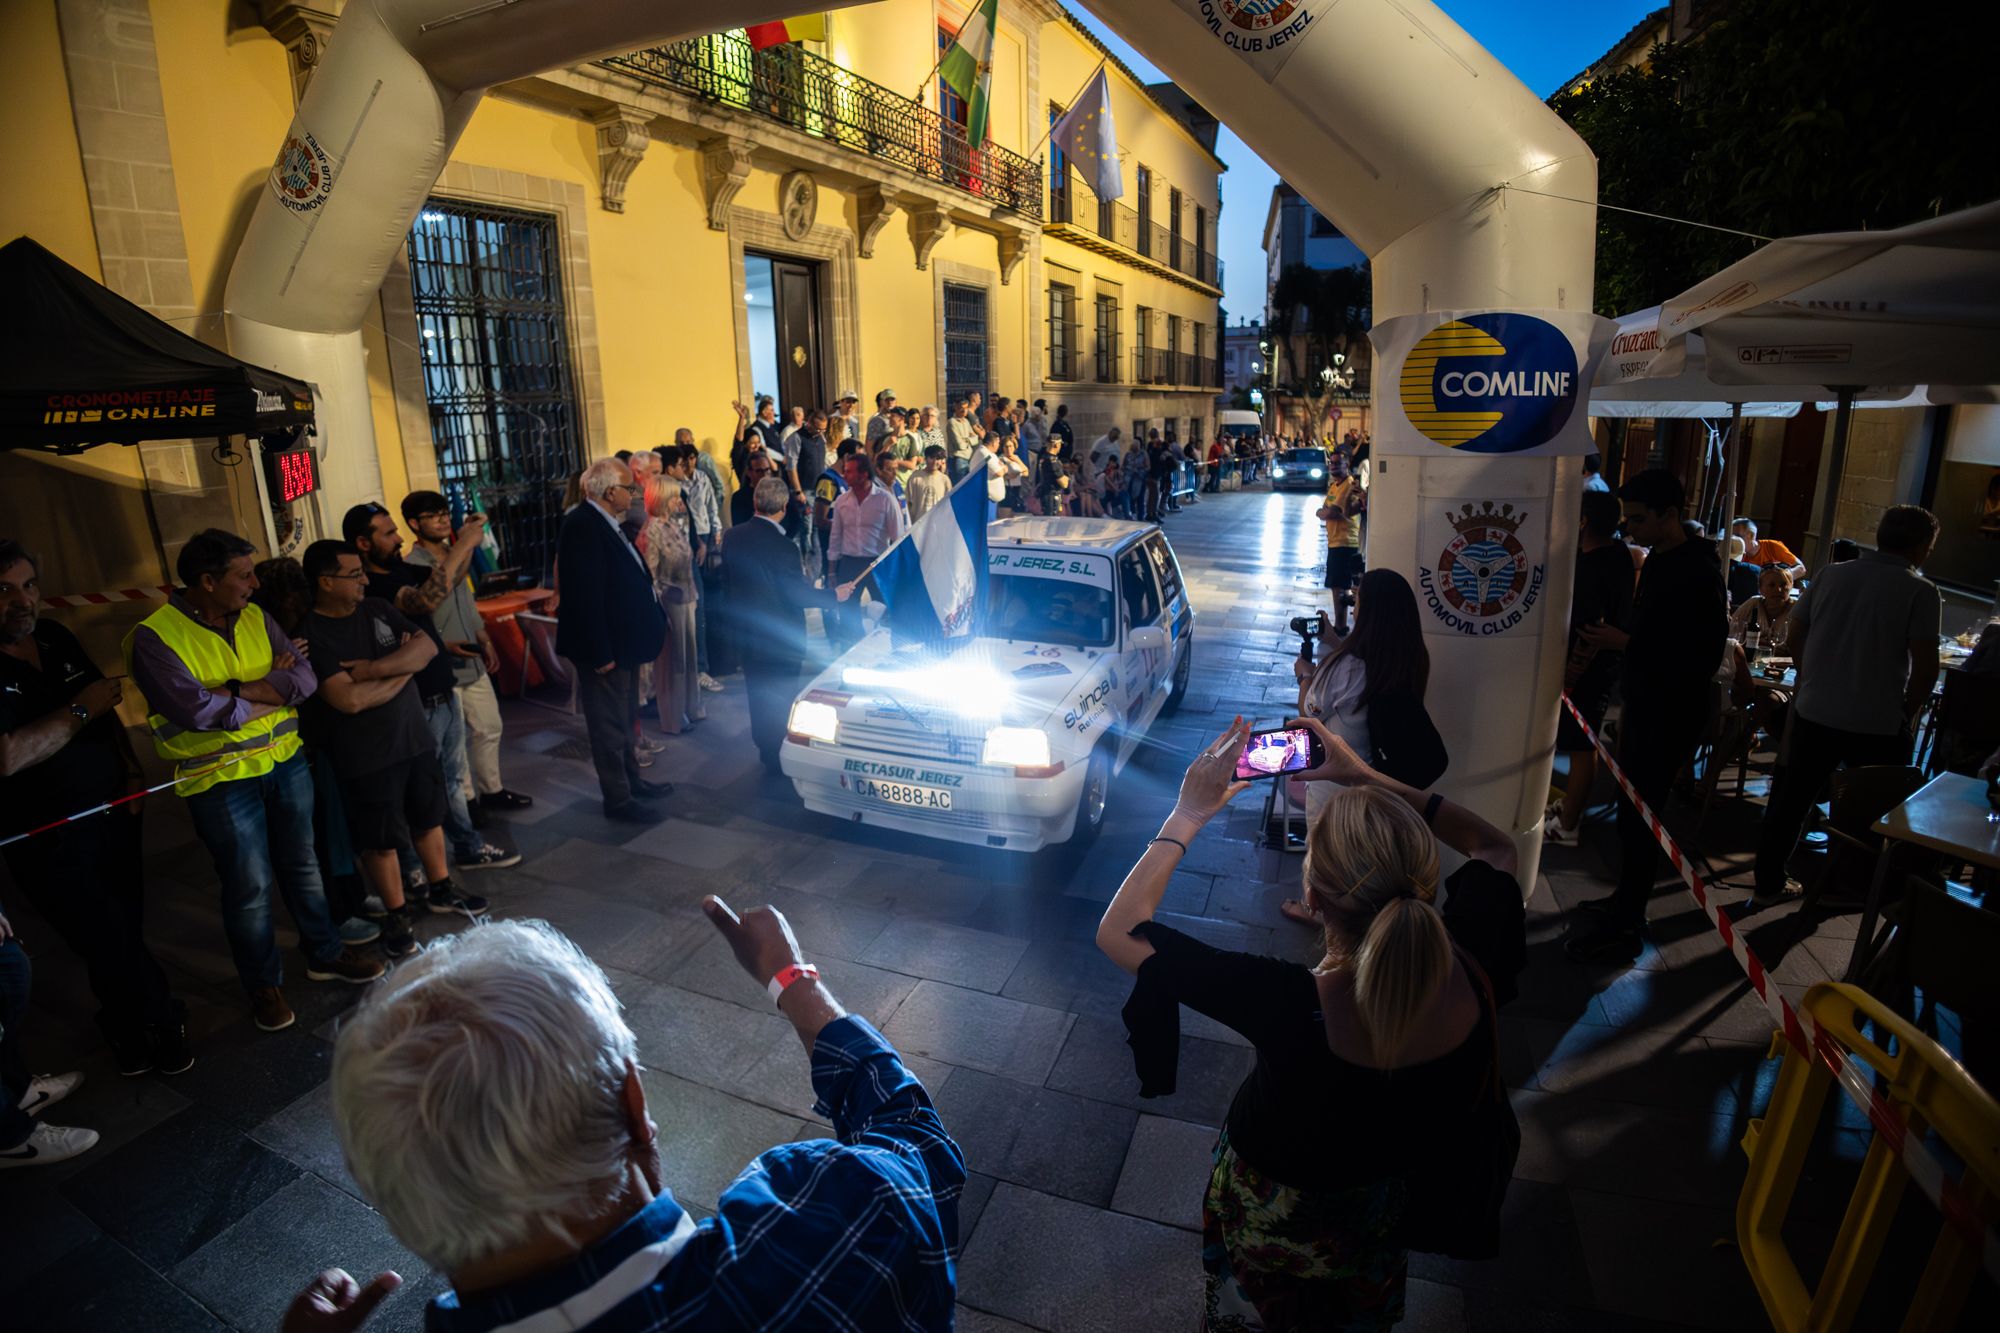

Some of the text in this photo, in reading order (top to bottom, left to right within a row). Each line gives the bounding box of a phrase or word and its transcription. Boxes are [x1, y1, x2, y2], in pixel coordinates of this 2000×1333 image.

[1223, 31, 1262, 51] CLUB
[1266, 9, 1314, 49] JEREZ
[280, 132, 332, 211] AUTOMOVIL CLUB JEREZ
[1611, 330, 1663, 356] Cruzcam
[1441, 371, 1570, 397] COMLINE
[47, 388, 217, 408] CRONOMETRAJE
[107, 404, 217, 421] ONLINE
[1013, 557, 1066, 574] JEREZ,
[1069, 561, 1096, 577] S.L.
[1419, 564, 1545, 635] AUTOMOVIL CLUB JEREZ
[844, 759, 964, 788] RECTASUR JEREZ
